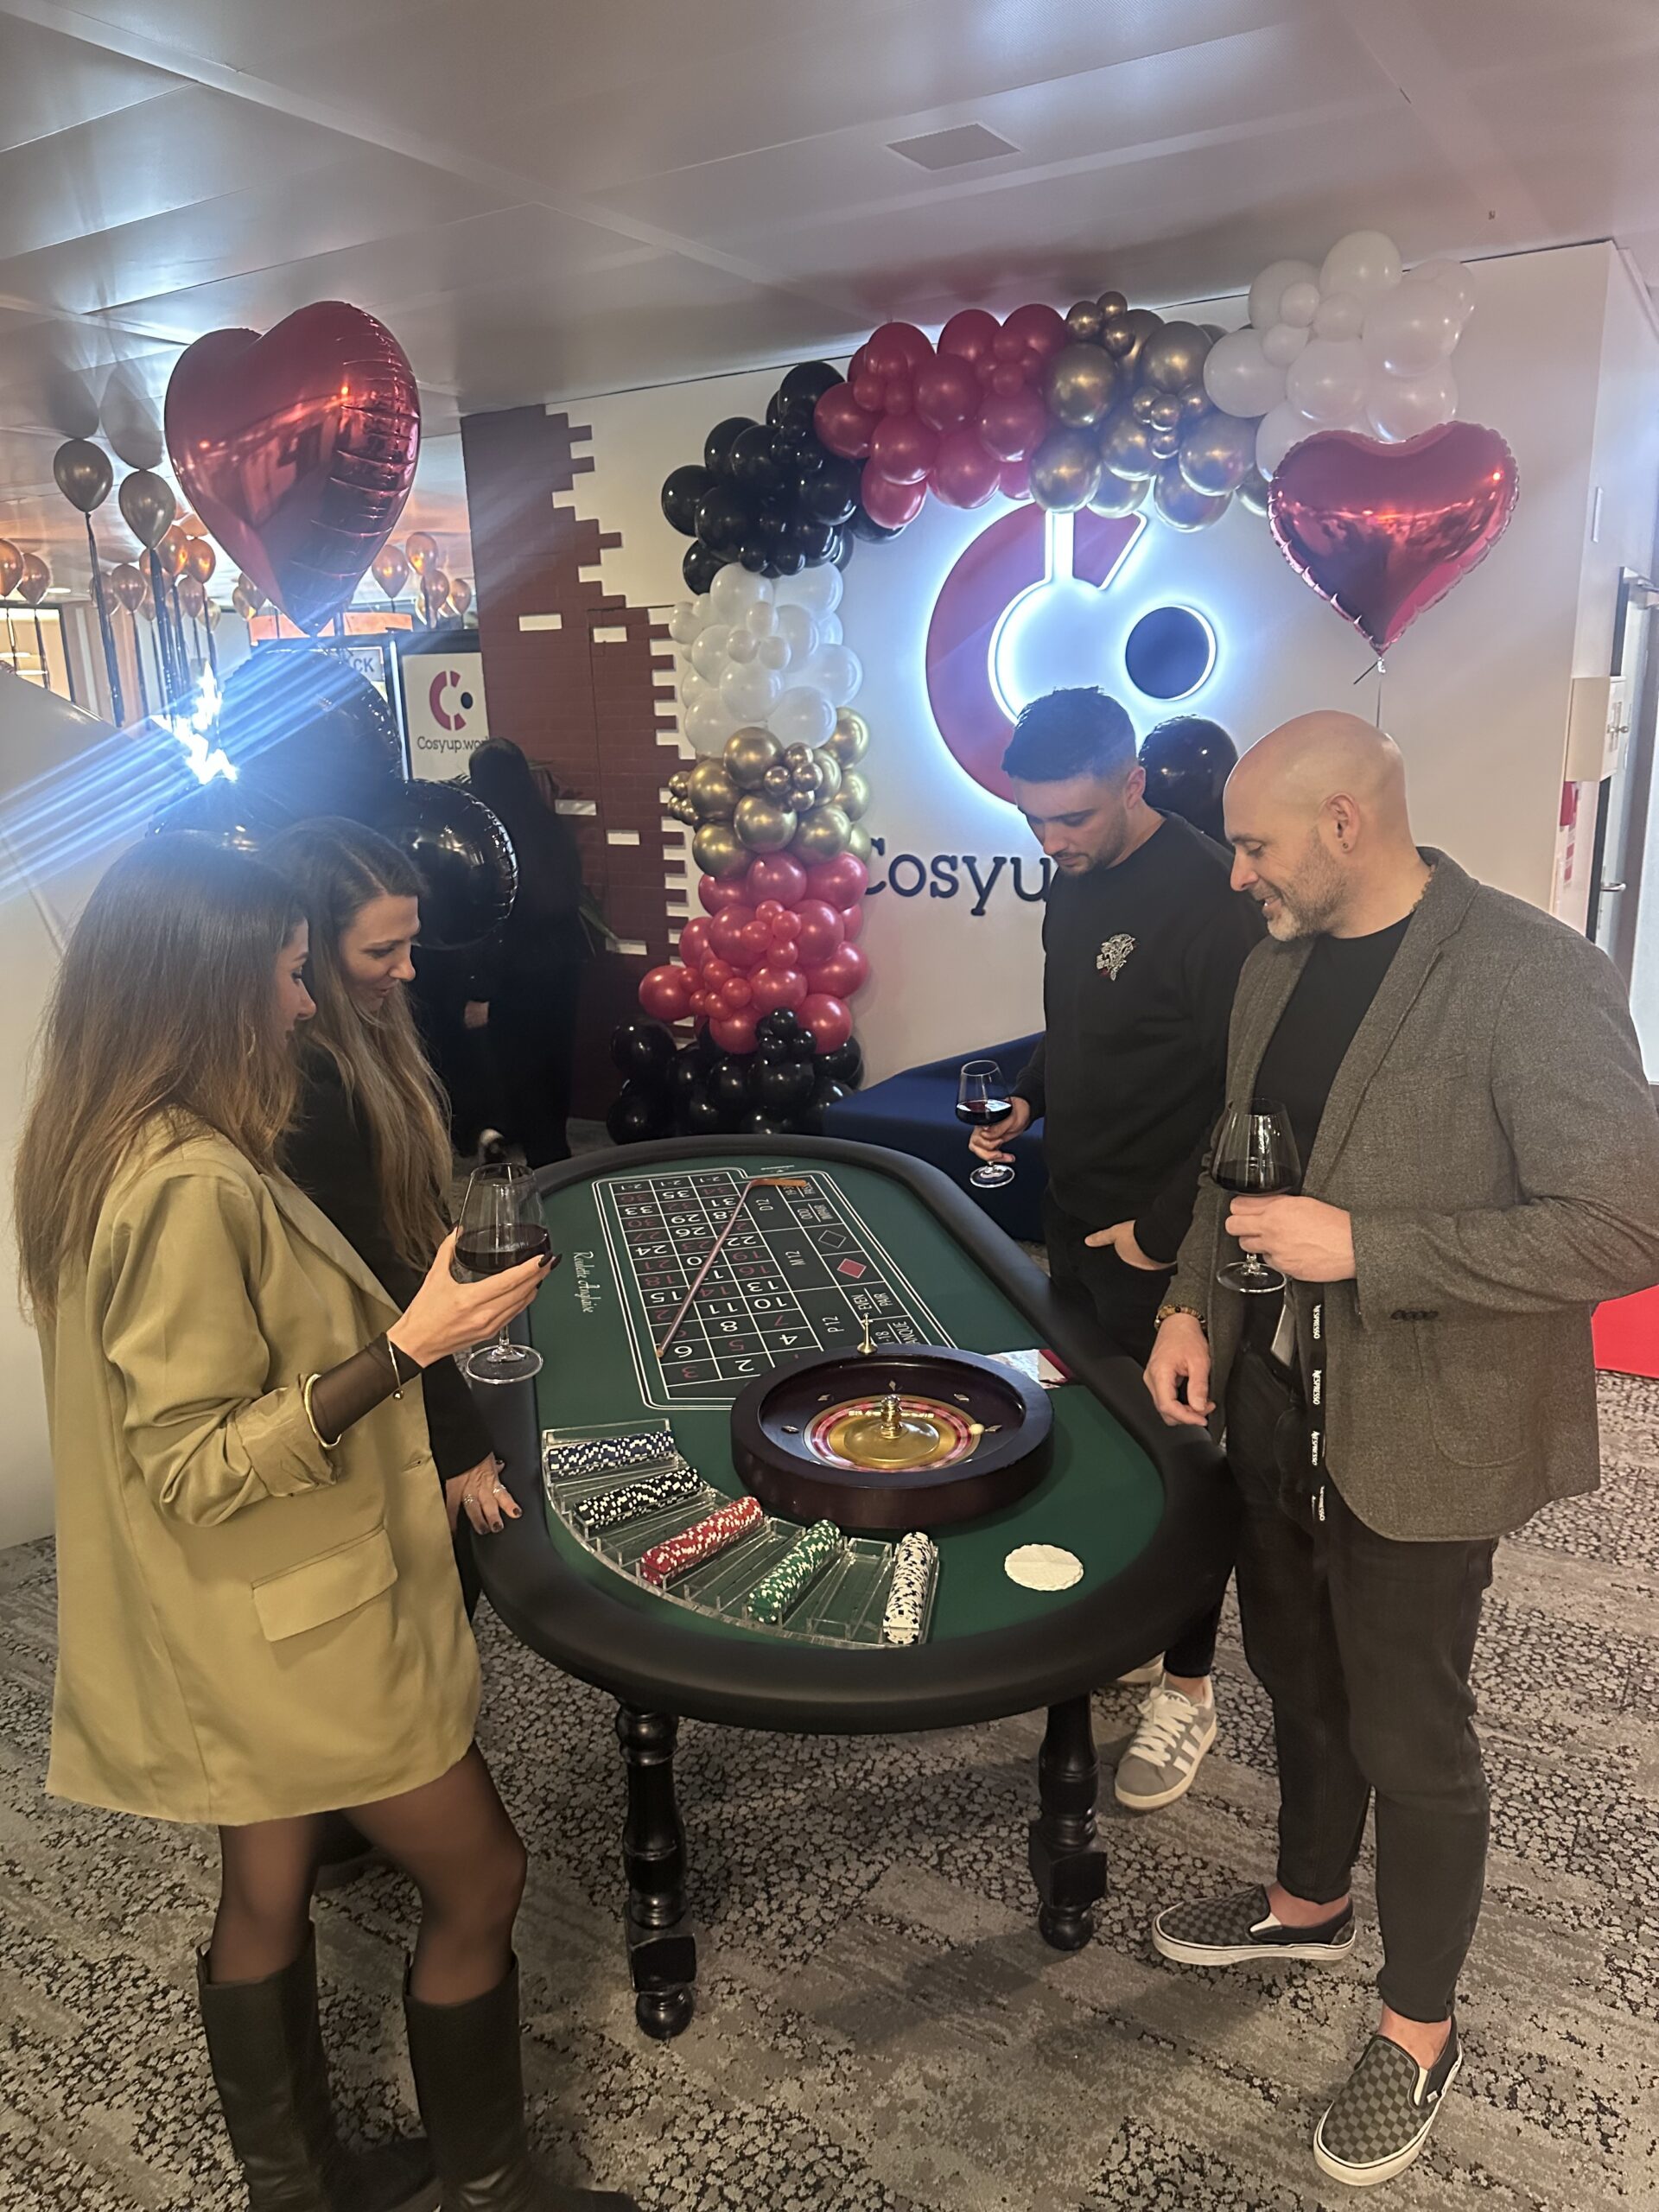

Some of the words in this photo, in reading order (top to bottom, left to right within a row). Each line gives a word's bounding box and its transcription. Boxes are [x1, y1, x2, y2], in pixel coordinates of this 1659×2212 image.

[662, 1190, 690, 1199] 35
[710, 1198, 736, 1207] 31
[625, 1205, 653, 1216] 33
[671, 1213, 701, 1224] 29
[675, 1226, 706, 1237] 26
[726, 1236, 757, 1246] 22
[635, 1244, 667, 1256] 24
[747, 1281, 779, 1292] 13
[651, 1291, 682, 1303] 15
[851, 1294, 873, 1311] EVEN
[709, 1302, 738, 1314] 11
[753, 1297, 787, 1309] 10
[720, 1320, 738, 1332] 8
[892, 1321, 922, 1345] ANQUE
[779, 1334, 799, 1345] 4
[735, 1359, 754, 1372] 2
